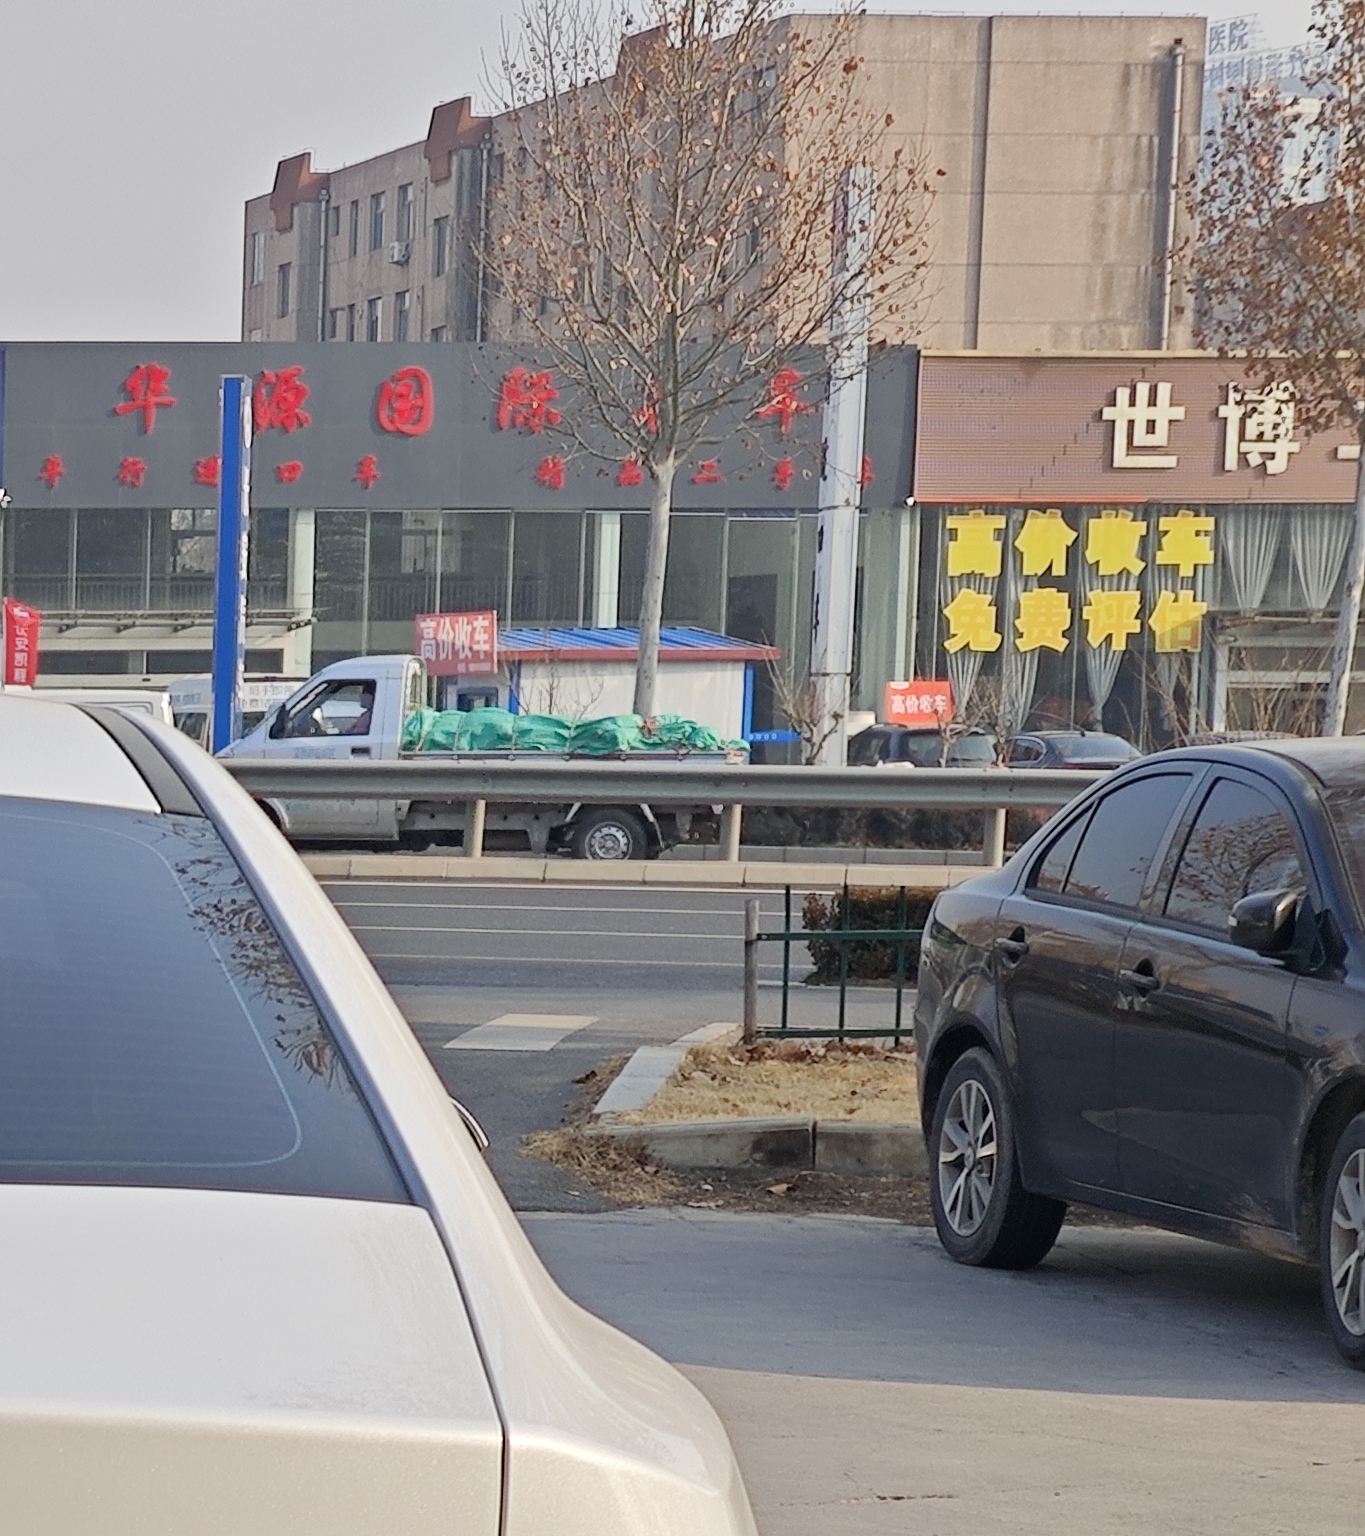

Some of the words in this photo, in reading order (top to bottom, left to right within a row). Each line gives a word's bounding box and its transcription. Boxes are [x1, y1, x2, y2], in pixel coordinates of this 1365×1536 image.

[1102, 381, 1361, 476] 世博
[945, 510, 1216, 578] 高价收车
[419, 615, 491, 662] 高价收车
[943, 588, 1211, 654] 免费评估
[891, 694, 949, 715] 高价收车
